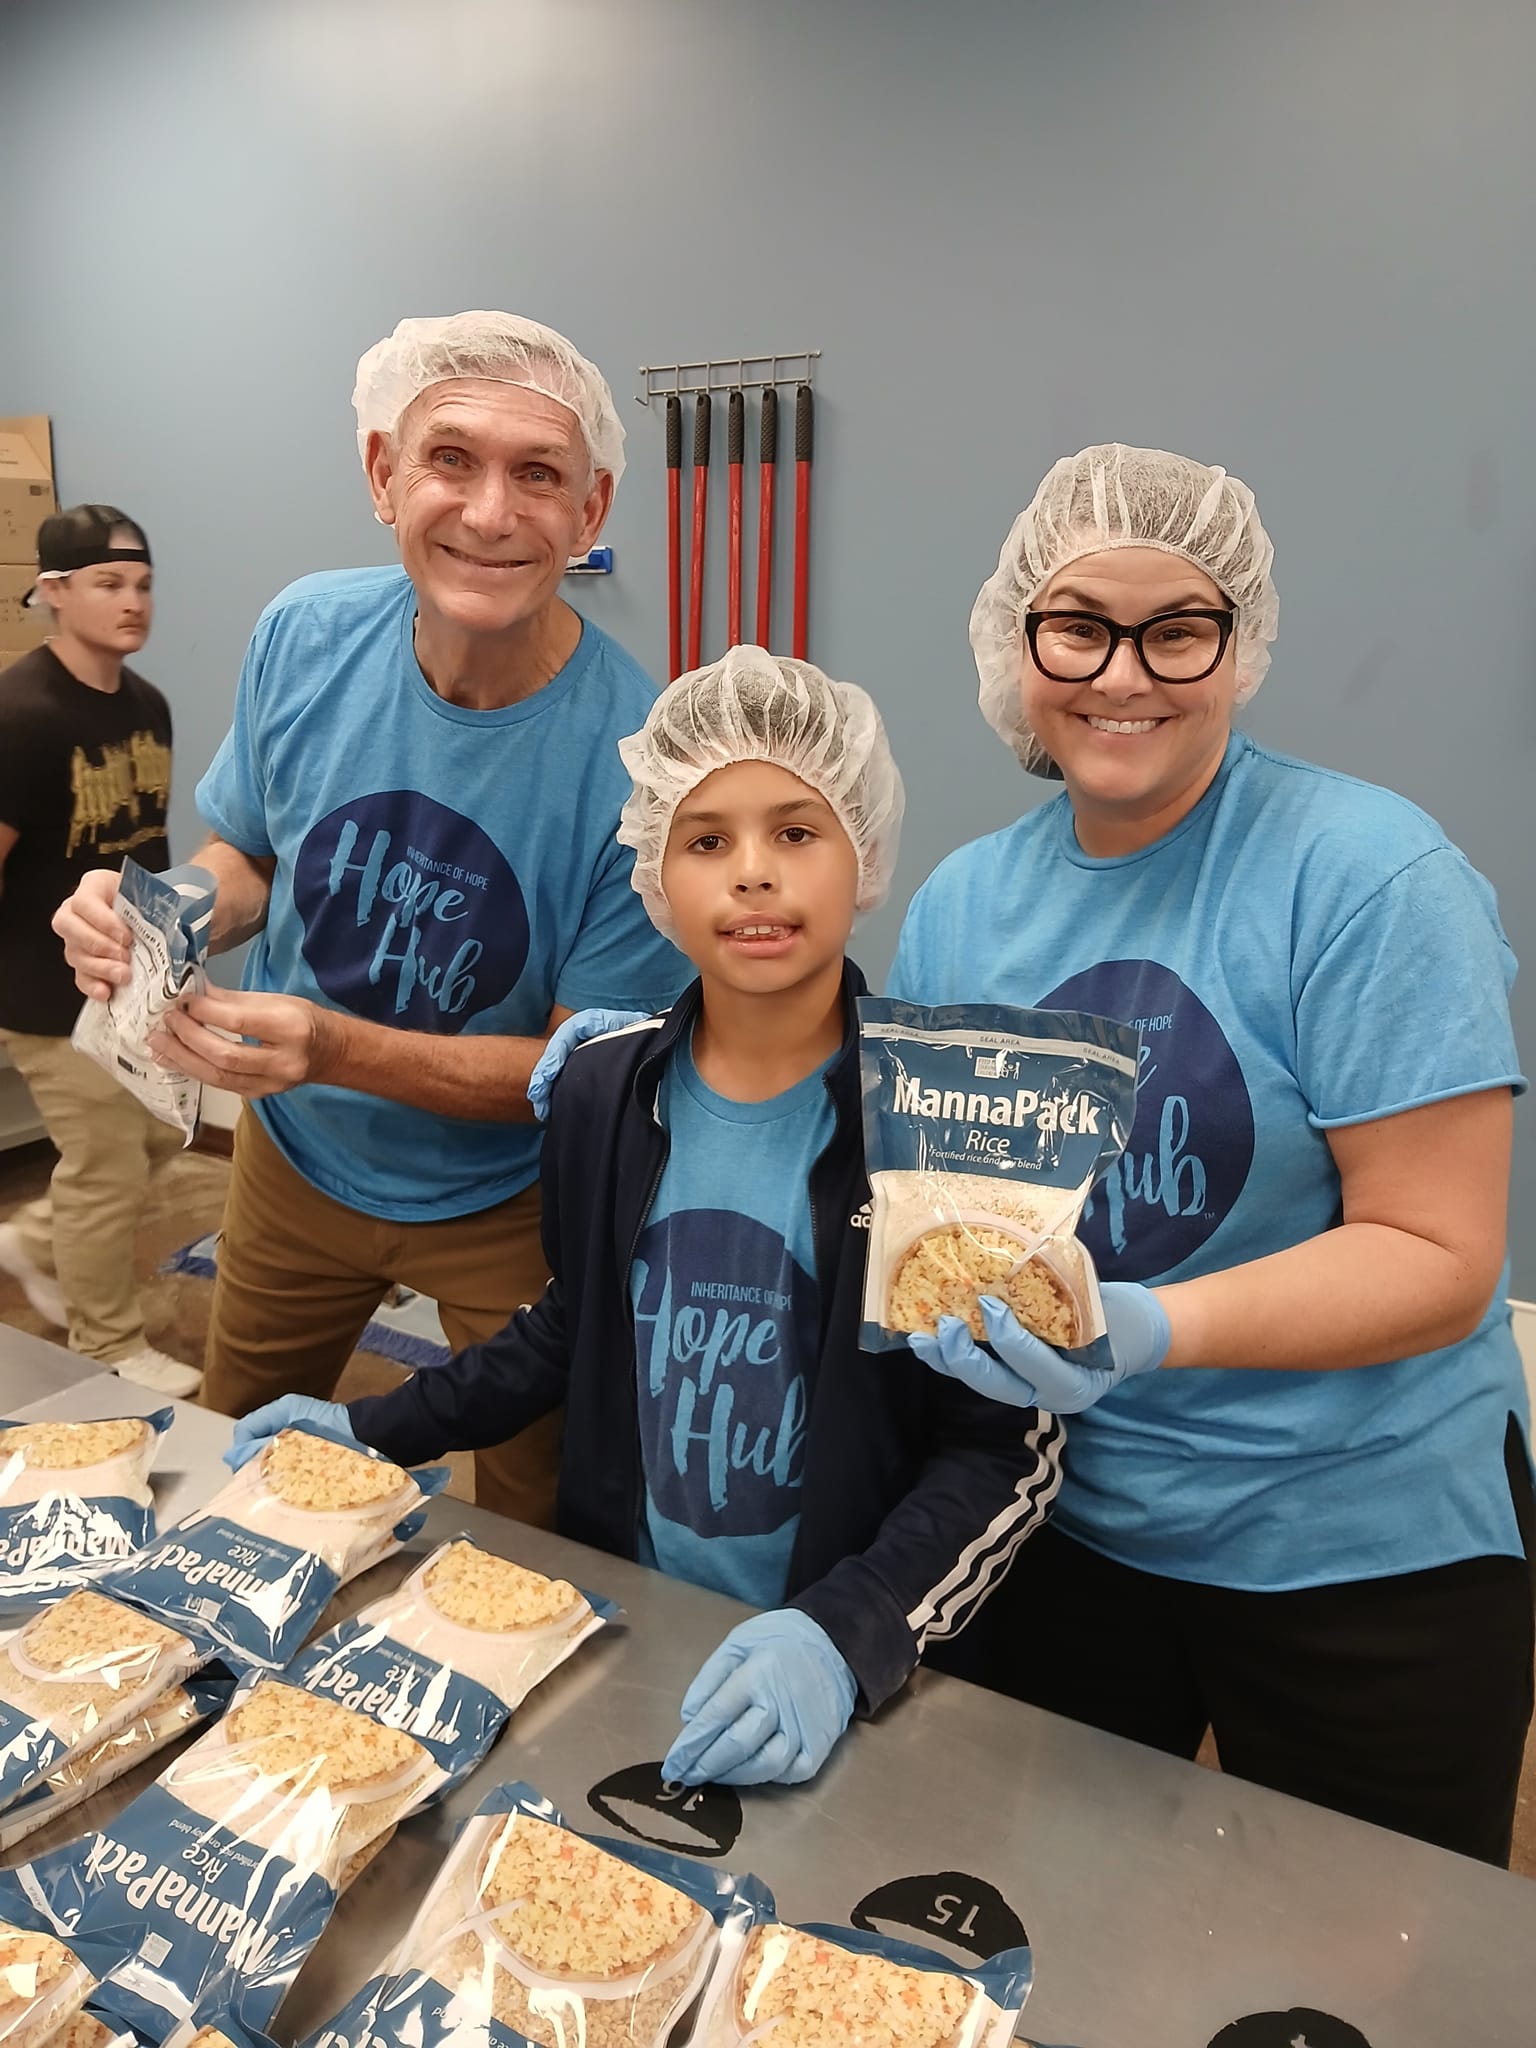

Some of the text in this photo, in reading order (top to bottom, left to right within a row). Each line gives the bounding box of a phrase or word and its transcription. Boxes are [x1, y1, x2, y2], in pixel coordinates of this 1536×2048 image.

[328, 819, 469, 928] Hope
[452, 866, 465, 881] OF
[464, 871, 489, 891] HOPE
[368, 912, 483, 1015] Hub
[1149, 1013, 1174, 1032] HOPE
[979, 1036, 1021, 1046] SEAL AREA
[1083, 1047, 1121, 1065] SEAL AREA
[892, 1075, 1100, 1135] MannaPack
[965, 1129, 1011, 1154] Rice
[930, 1148, 966, 1161] Fortified
[966, 1154, 982, 1163] rice
[983, 1154, 1001, 1165] and
[1017, 1158, 1042, 1170] blend
[690, 1281, 762, 1304] INHERITANCE
[630, 1257, 782, 1399] Hope
[226, 1545, 262, 1567] Rice
[182, 1842, 229, 1884] Rice
[83, 1832, 280, 1975] MannaPack
[926, 1893, 980, 1938] 15
